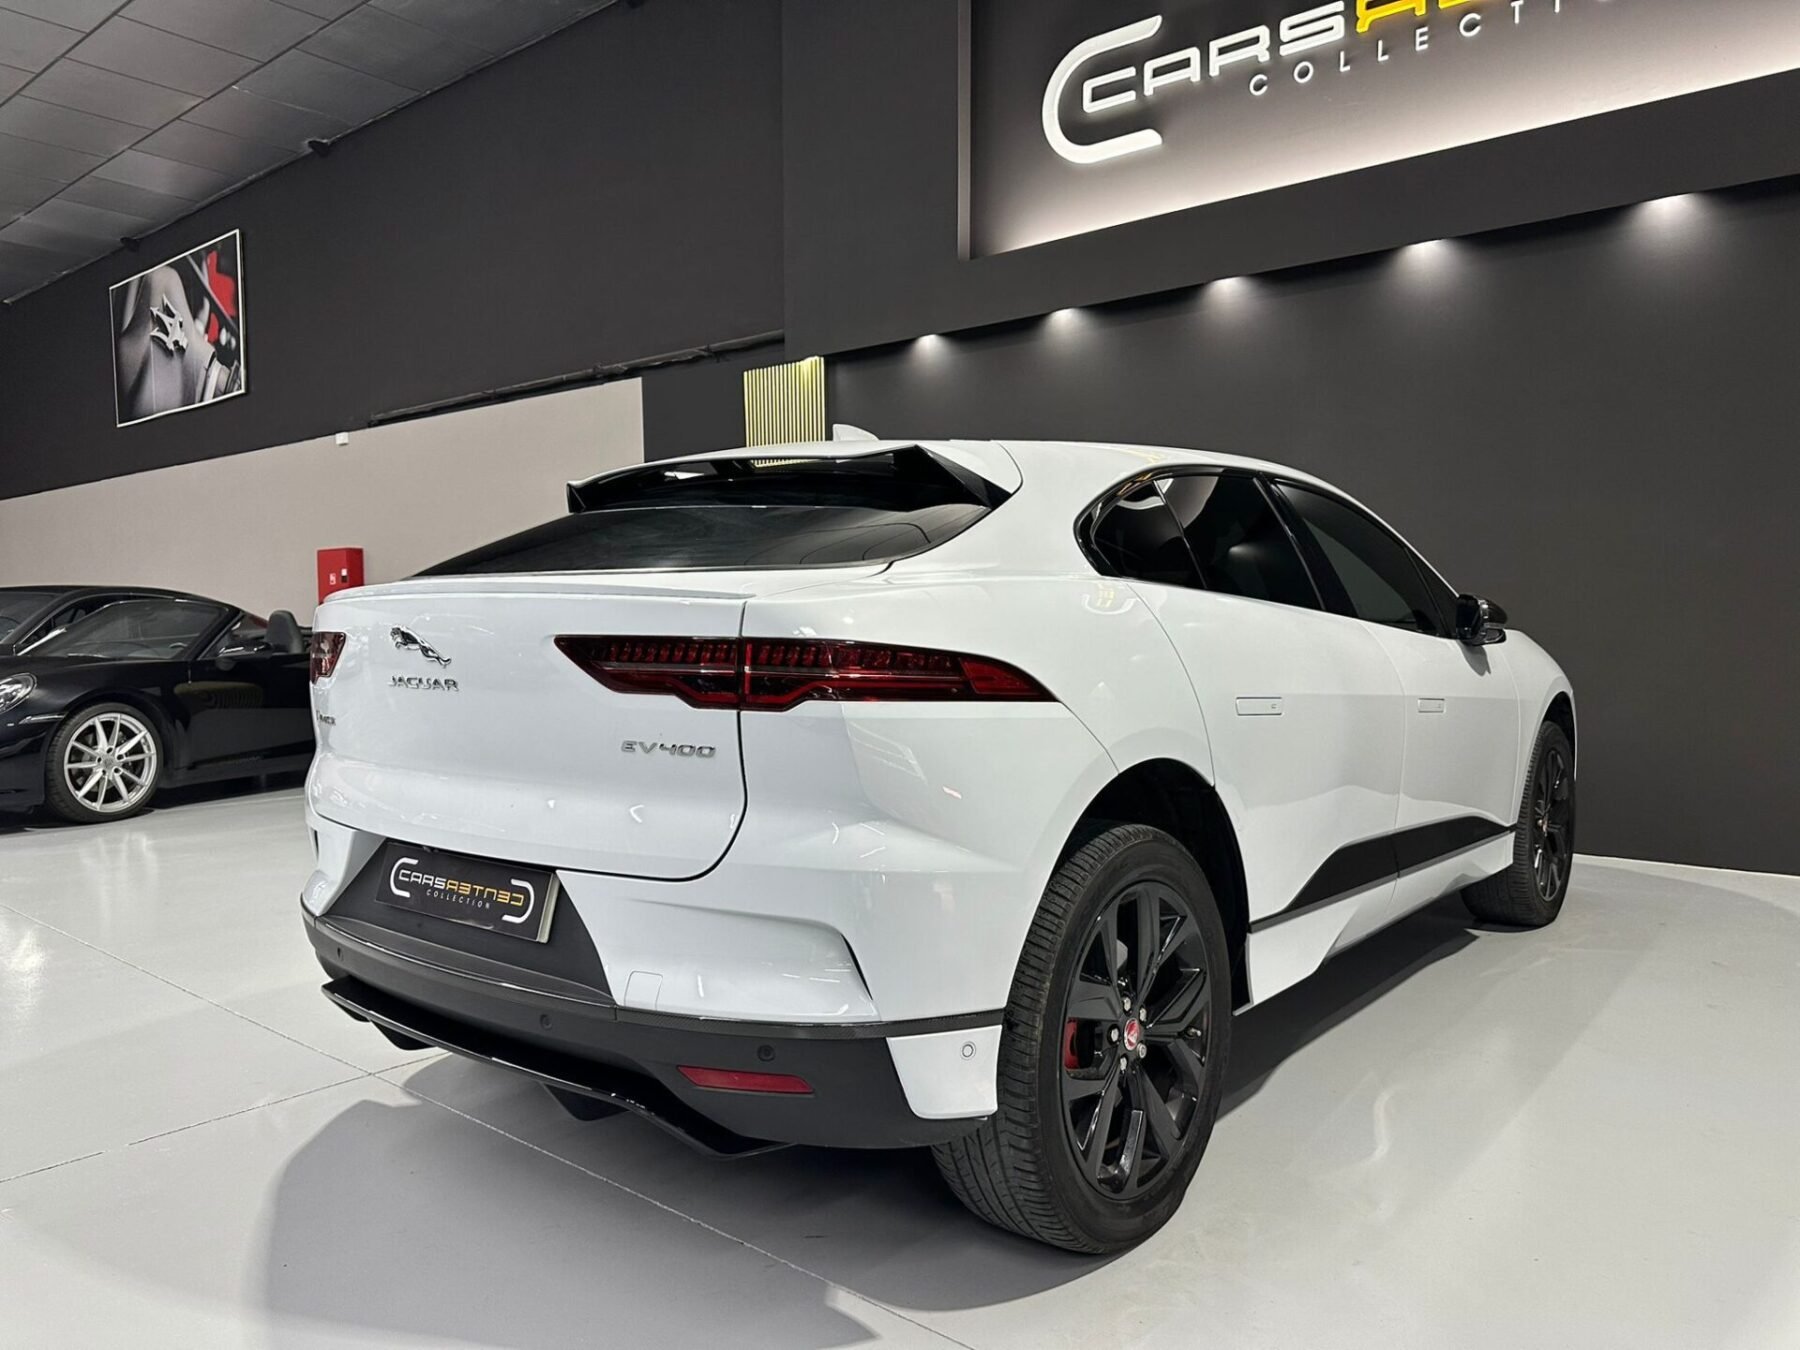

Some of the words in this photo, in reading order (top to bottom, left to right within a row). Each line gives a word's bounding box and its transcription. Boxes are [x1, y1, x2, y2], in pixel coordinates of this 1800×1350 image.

[388, 675, 460, 692] JAGUAR
[620, 740, 716, 759] EV400
[425, 888, 491, 910] COLLECTION
